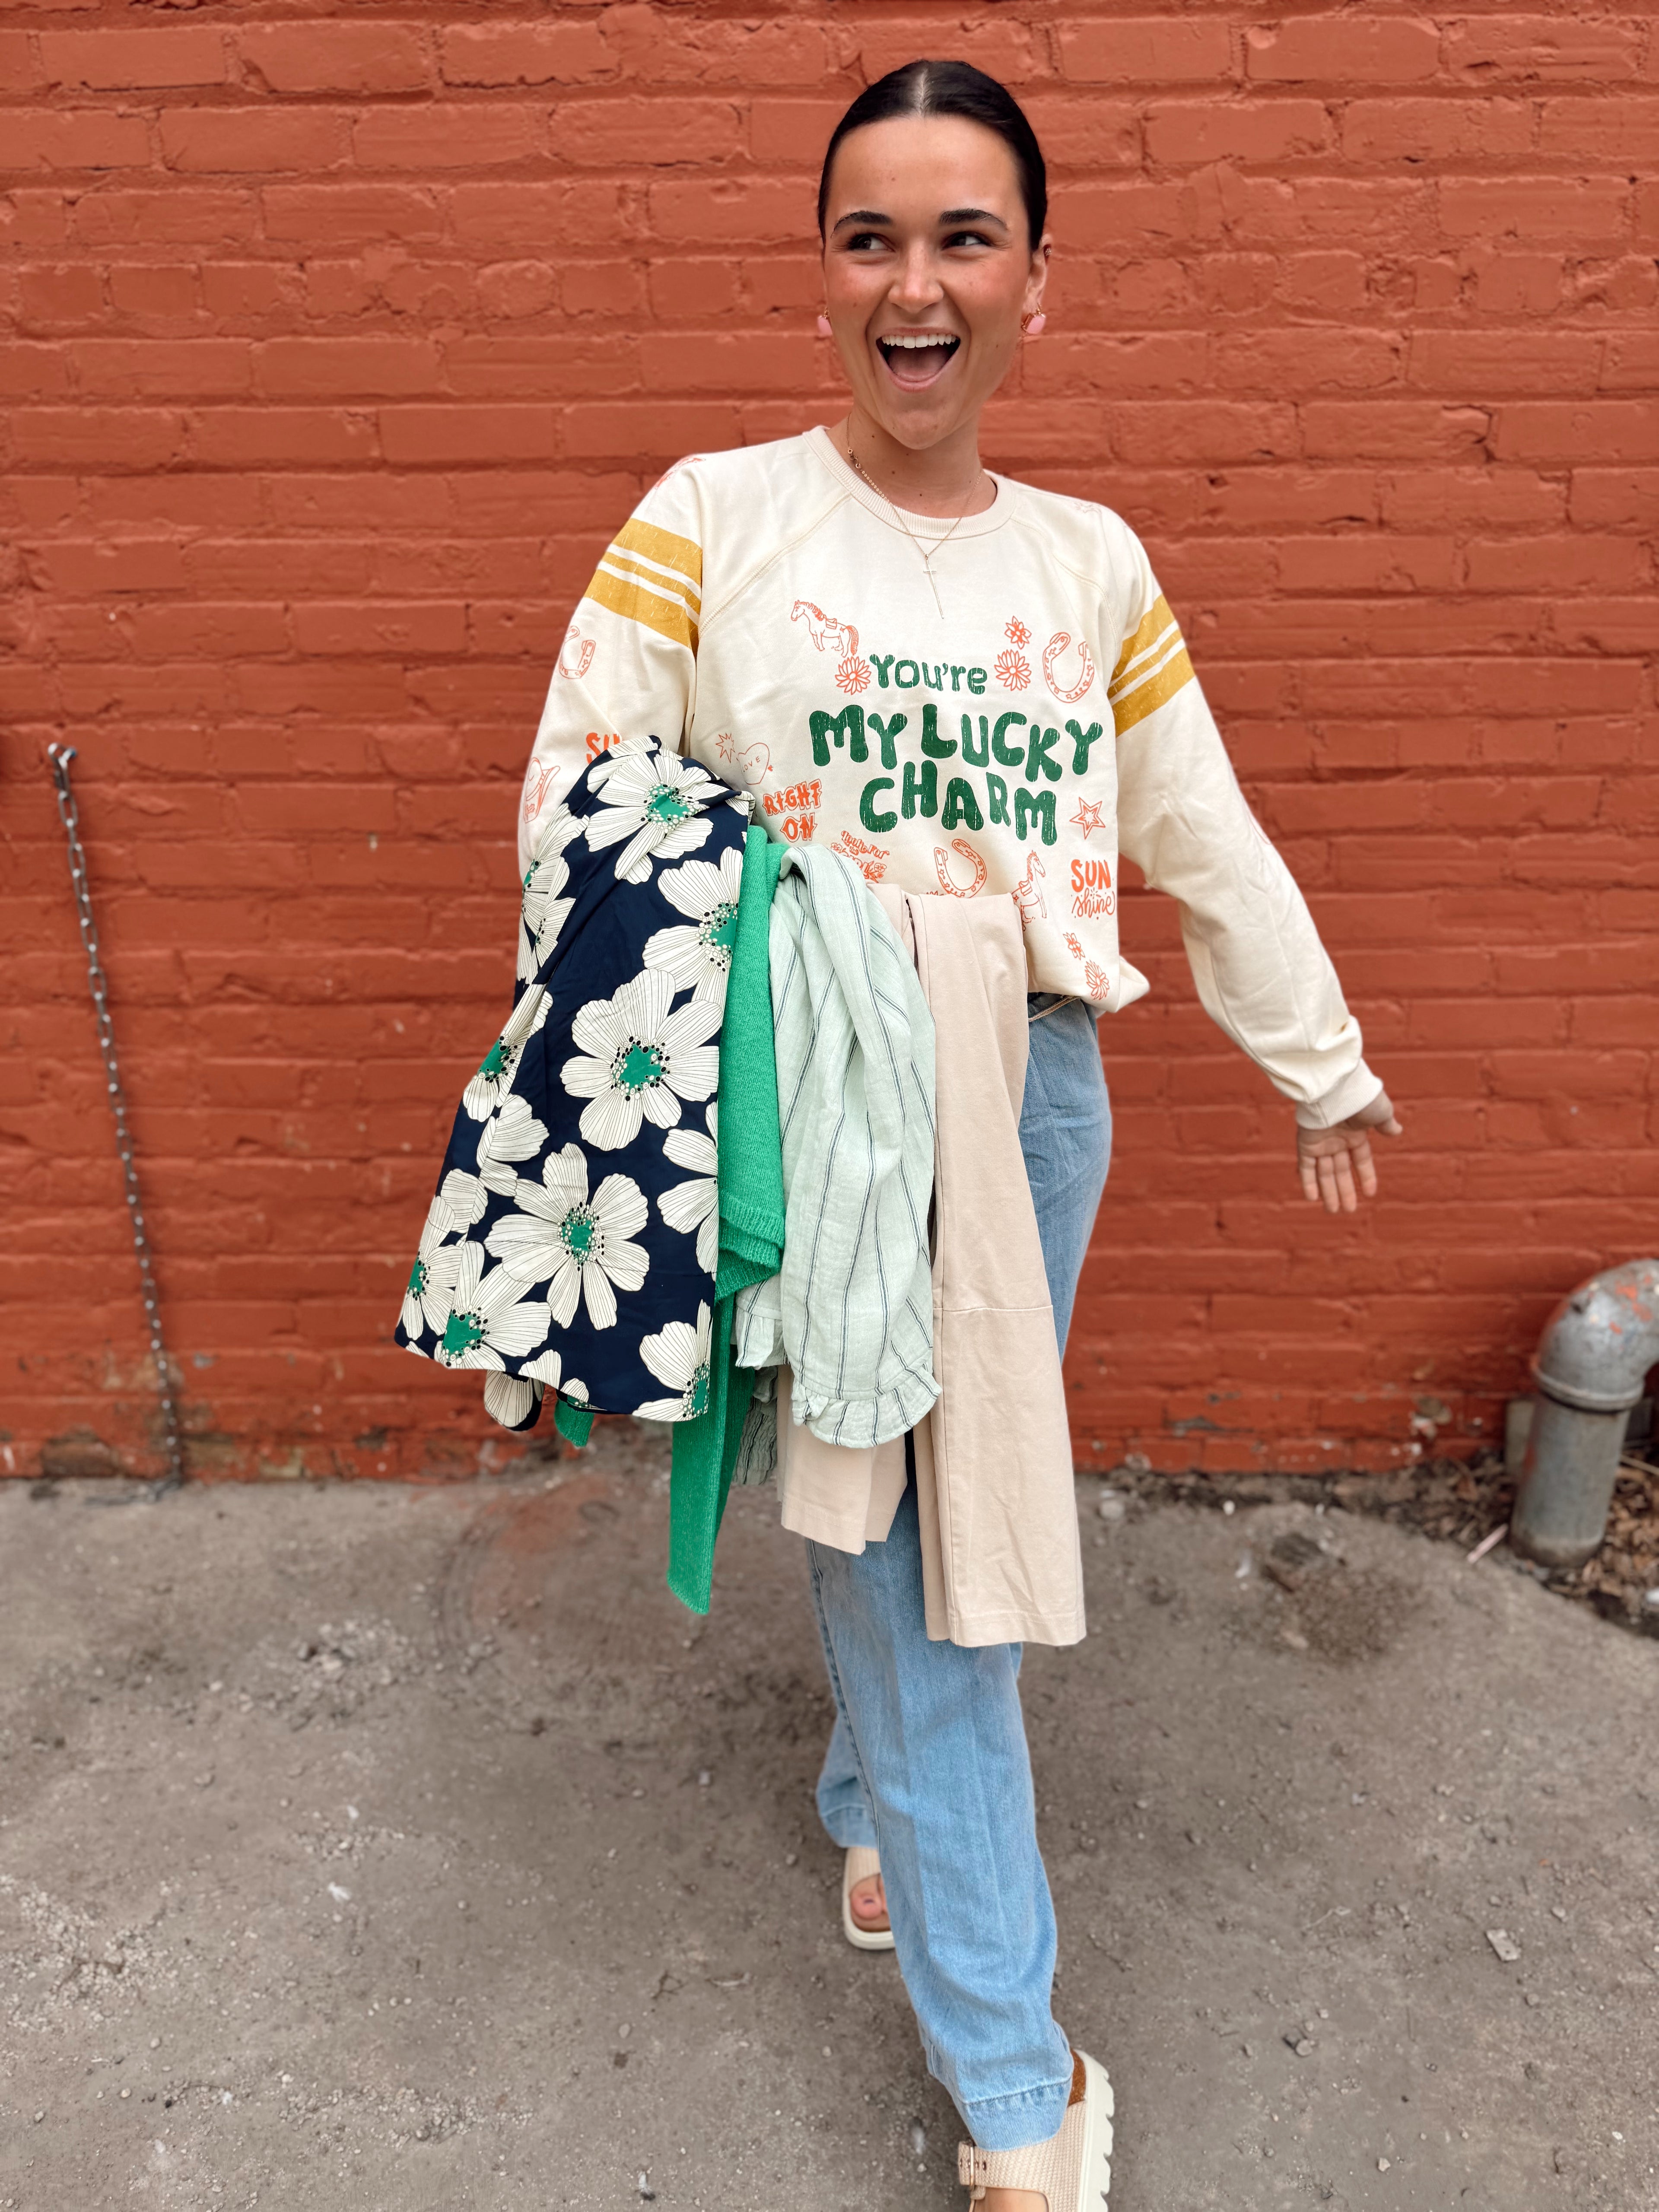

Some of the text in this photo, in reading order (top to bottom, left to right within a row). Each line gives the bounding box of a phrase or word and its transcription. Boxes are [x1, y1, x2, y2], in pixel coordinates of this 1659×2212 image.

[869, 654, 988, 695] You're
[809, 704, 1103, 782] MY LUCKY
[742, 756, 761, 772] LOVE
[763, 779, 822, 816] RIGHT
[859, 760, 1058, 845] CHARM
[780, 813, 817, 842] ON
[1071, 859, 1111, 893] SUN
[1071, 887, 1116, 918] shine
